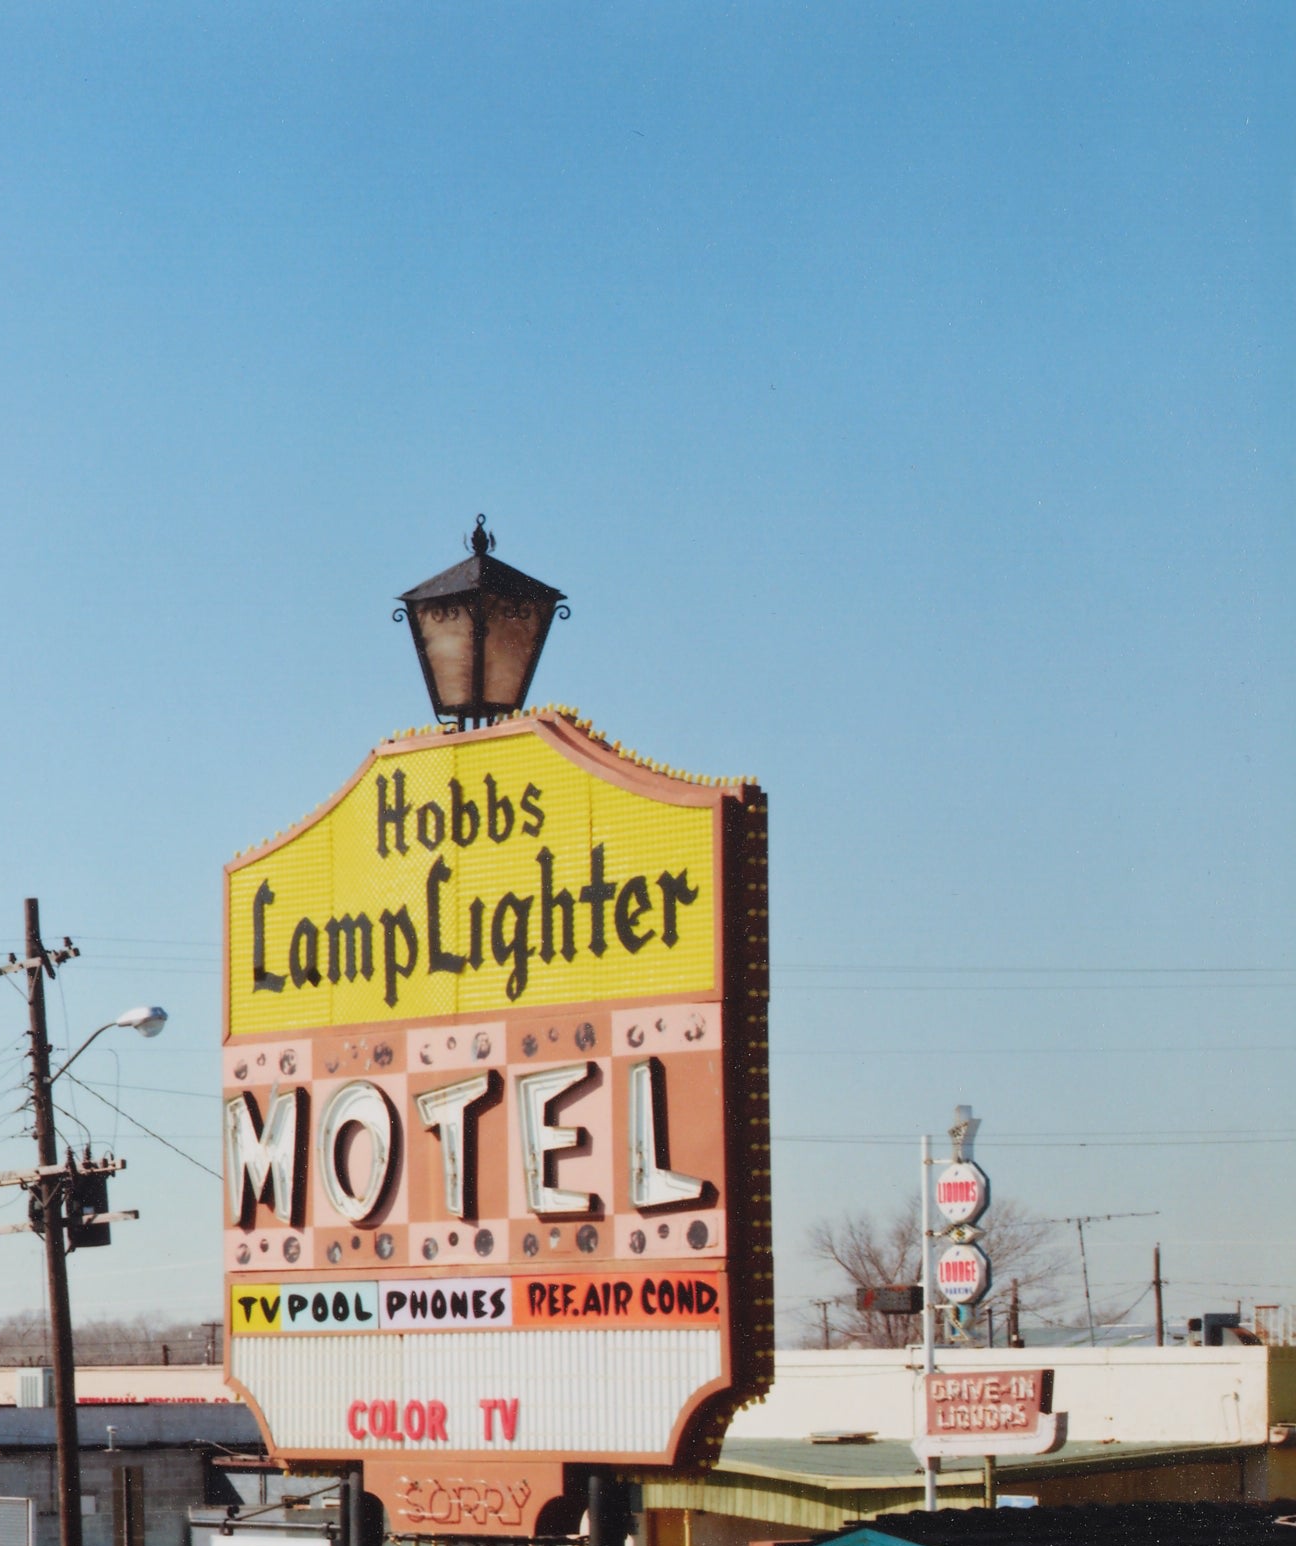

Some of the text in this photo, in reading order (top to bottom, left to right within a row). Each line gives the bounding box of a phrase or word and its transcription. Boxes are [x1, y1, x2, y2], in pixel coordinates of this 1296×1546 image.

[376, 768, 546, 858] Hobbs
[225, 1057, 719, 1230] MOTEL
[937, 1181, 977, 1203] LIQUORS
[939, 1261, 977, 1283] LOUNGE
[237, 1295, 280, 1325] TV
[287, 1292, 374, 1324] POOL
[386, 1287, 507, 1321] PHONES
[641, 1279, 720, 1316] COND.
[930, 1376, 1036, 1403] DRIVE-IN
[347, 1398, 520, 1442] COLOR TV
[936, 1403, 1028, 1430] LIQUORS
[406, 1479, 532, 1526] SORRY
